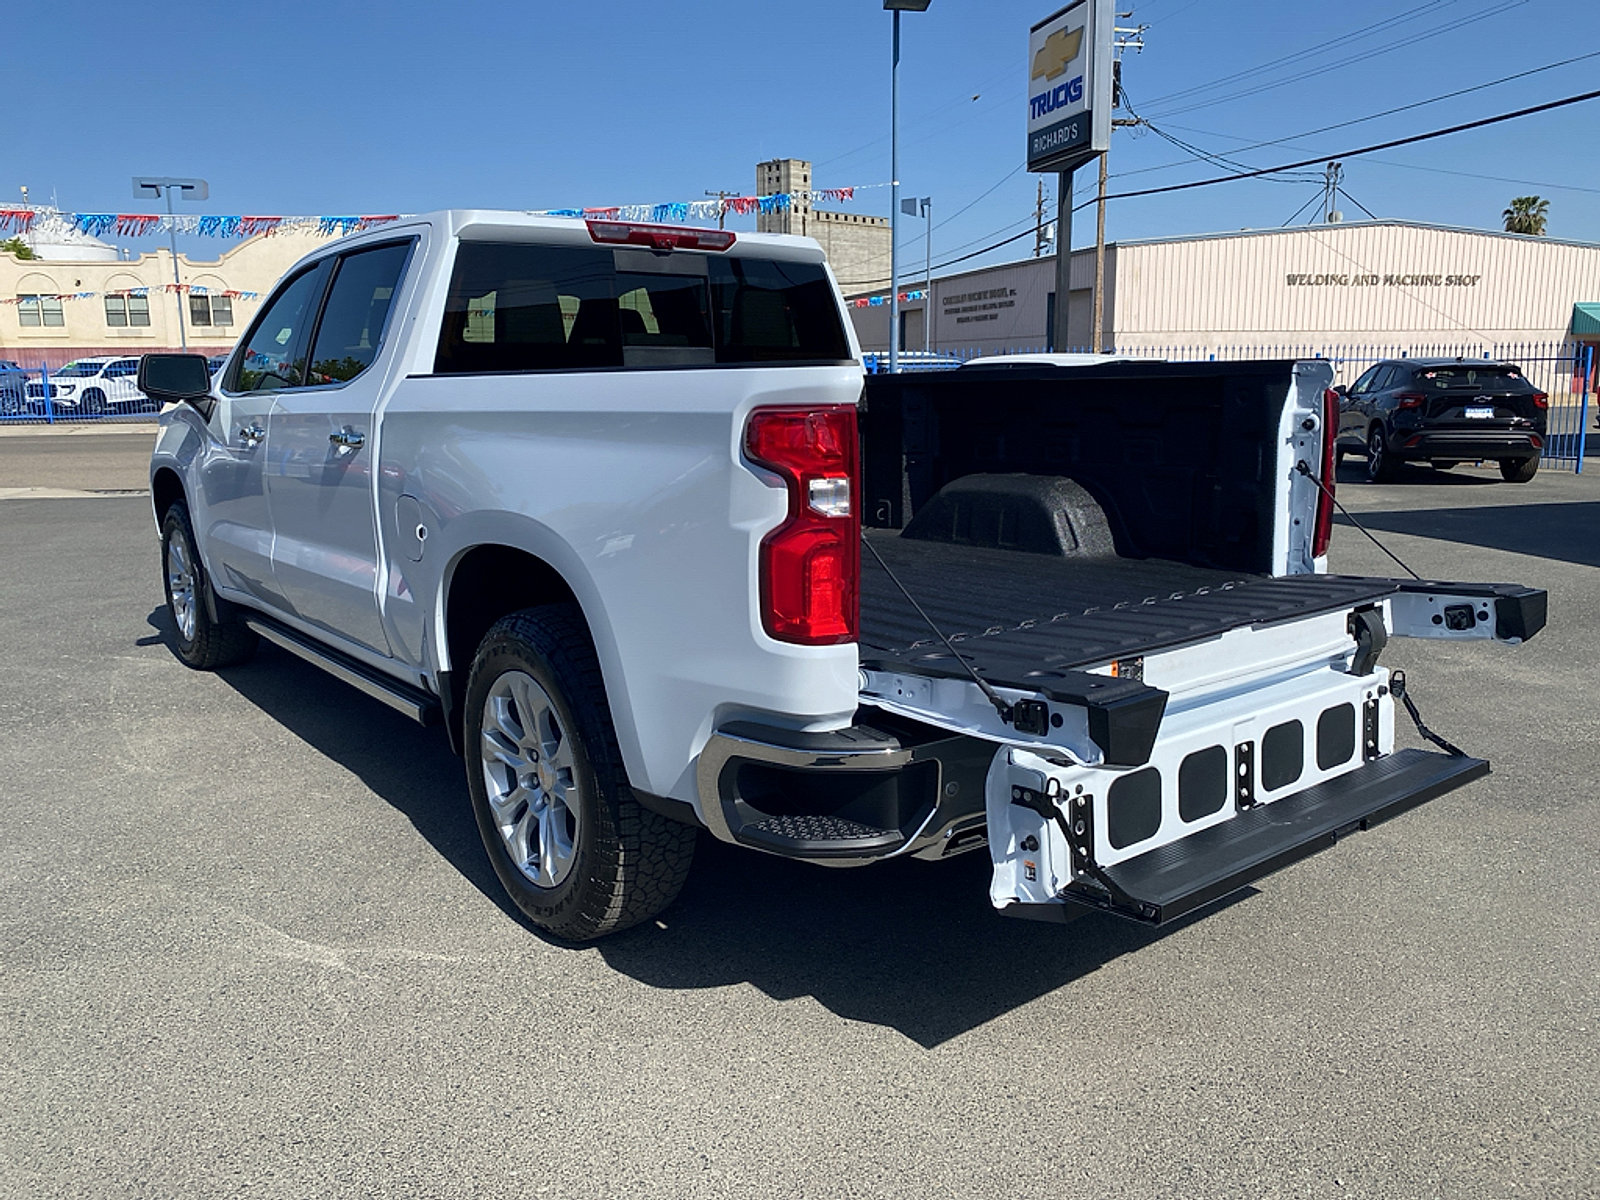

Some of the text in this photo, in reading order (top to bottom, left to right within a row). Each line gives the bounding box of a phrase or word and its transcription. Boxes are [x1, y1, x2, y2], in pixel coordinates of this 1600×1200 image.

[1030, 75, 1083, 120] TRUCKS
[1033, 123, 1078, 154] RICHARD'S
[1286, 273, 1481, 287] WELDING AND MACHINE SHOP
